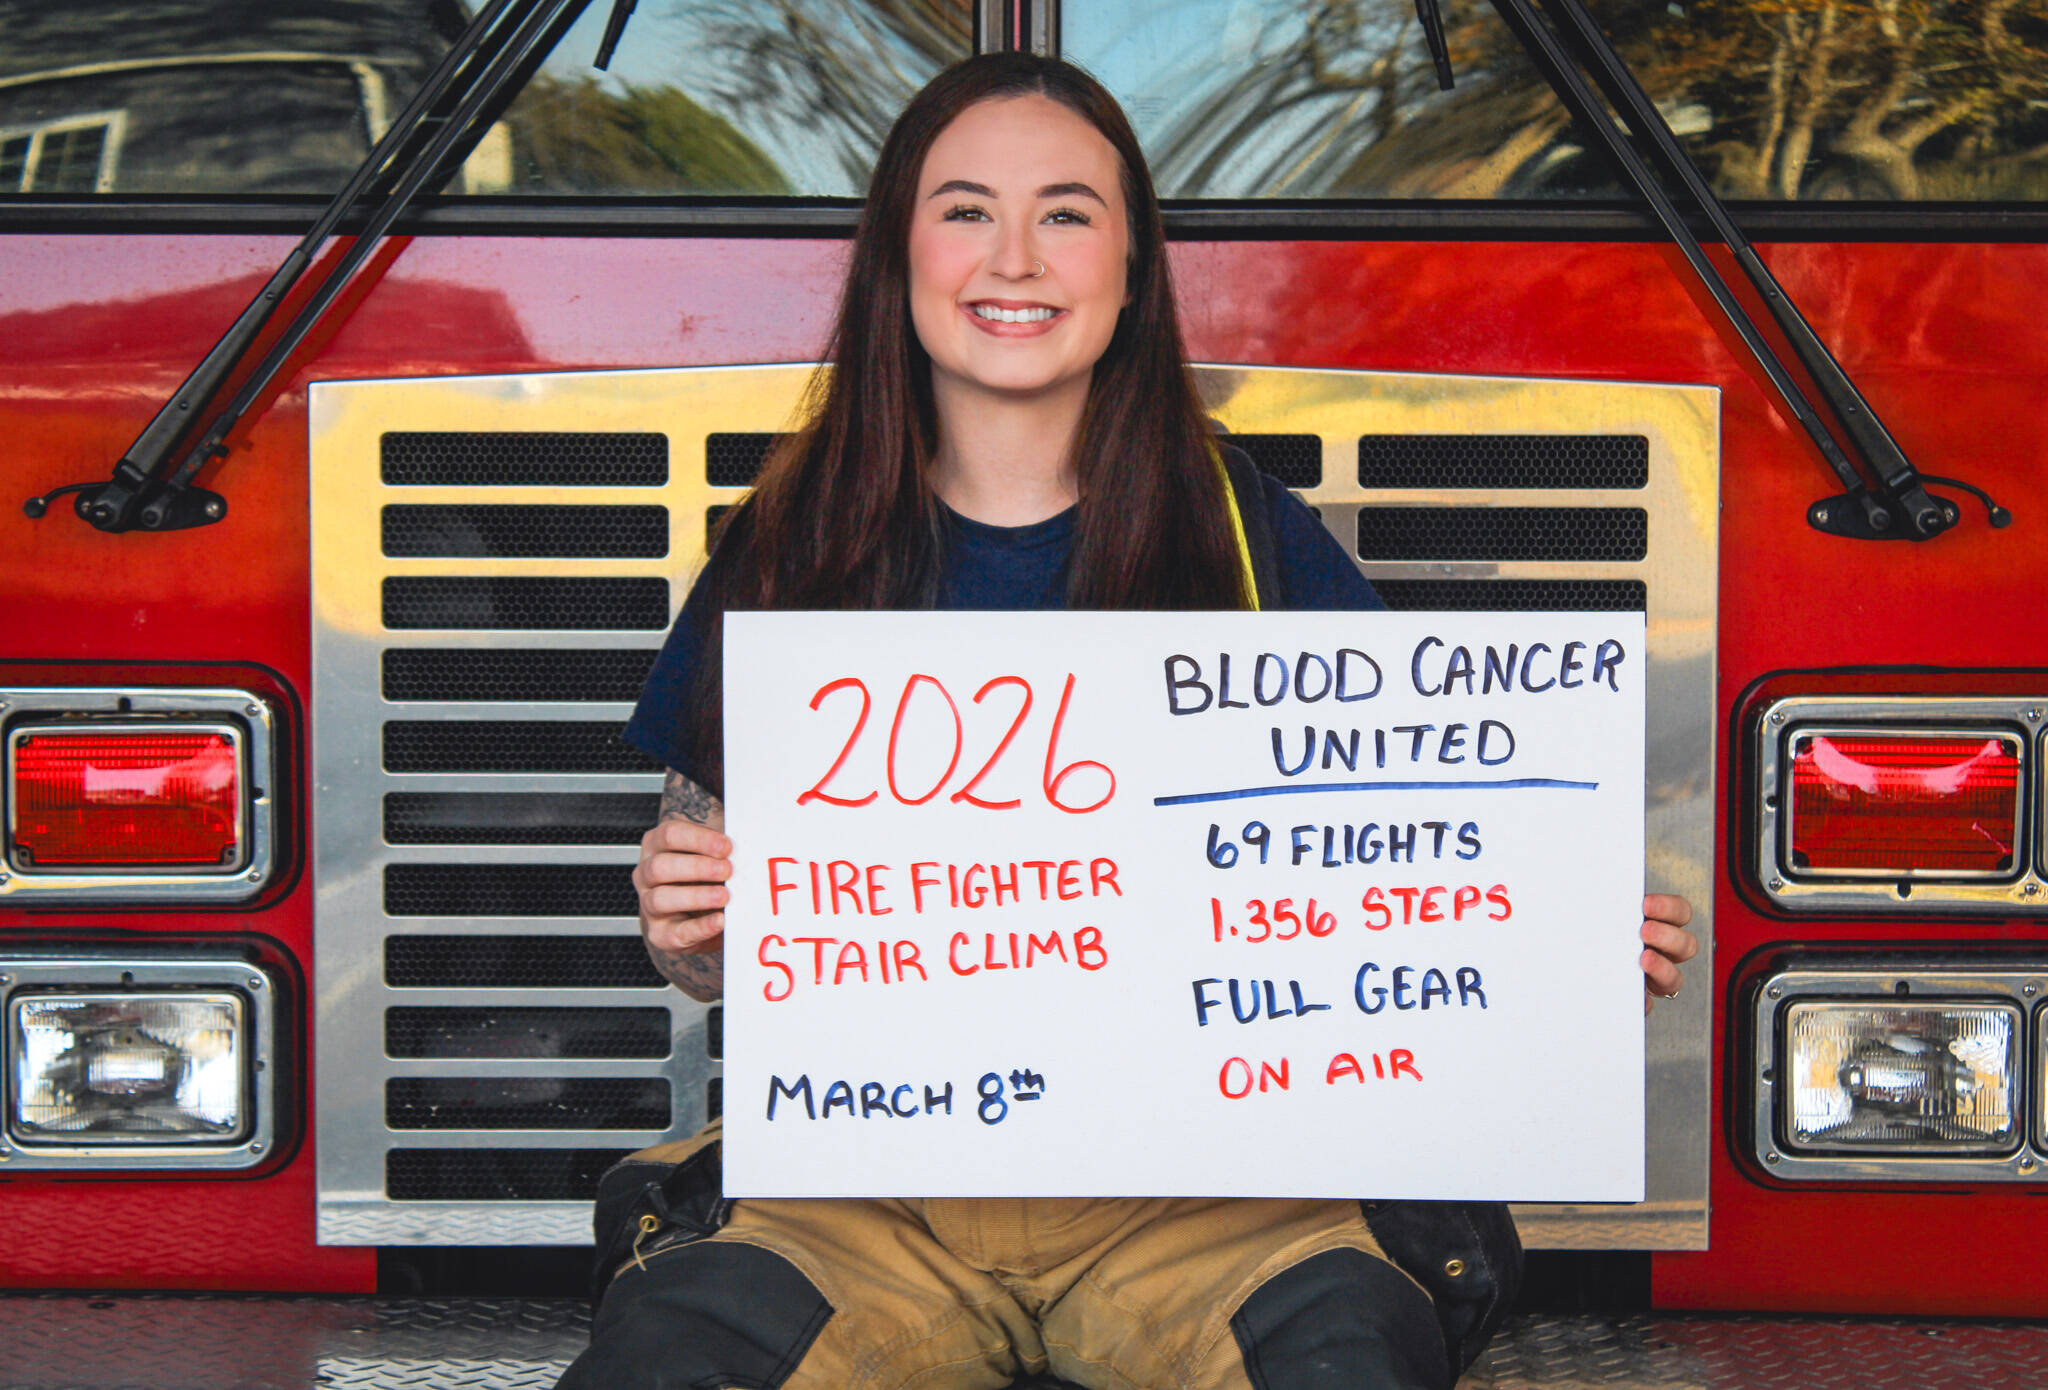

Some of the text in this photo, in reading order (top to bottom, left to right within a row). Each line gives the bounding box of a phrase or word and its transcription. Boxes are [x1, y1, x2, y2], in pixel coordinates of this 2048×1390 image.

[1165, 636, 1625, 715] BLOOD CANCER
[797, 674, 1116, 813] 2026
[1272, 720, 1515, 776] UNITED
[1207, 821, 1481, 869] 69 FLIGHTS
[768, 857, 1122, 916] FIRE FIGHTER
[1362, 884, 1512, 930] STEPS
[758, 927, 1107, 1001] STAIR CLIMB
[1192, 962, 1487, 1026] FULL GEAR
[767, 1074, 952, 1121] MARCH
[1219, 1049, 1422, 1099] ON AIR
